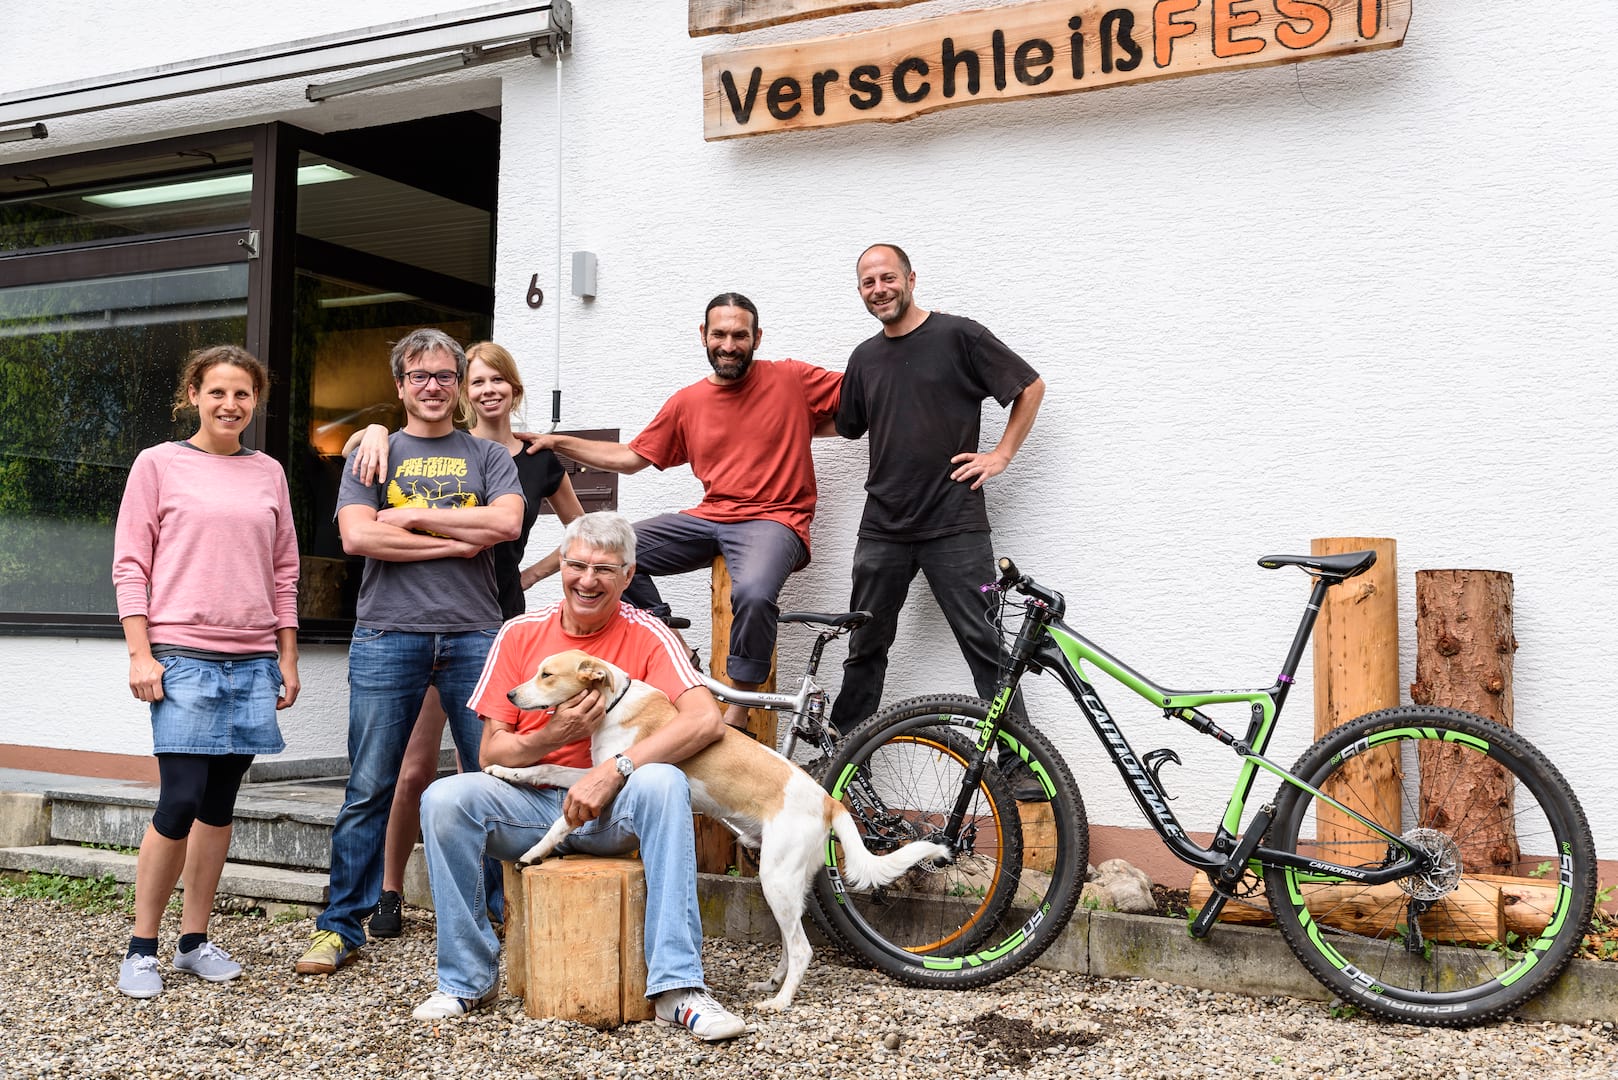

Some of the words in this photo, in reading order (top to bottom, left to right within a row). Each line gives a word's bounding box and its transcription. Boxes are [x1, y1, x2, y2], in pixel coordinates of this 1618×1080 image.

[526, 273, 544, 310] 6
[394, 464, 468, 479] FREIBURG
[903, 965, 957, 978] RACING
[961, 955, 1009, 977] RALPH
[1350, 984, 1468, 1013] SCHWALBE
